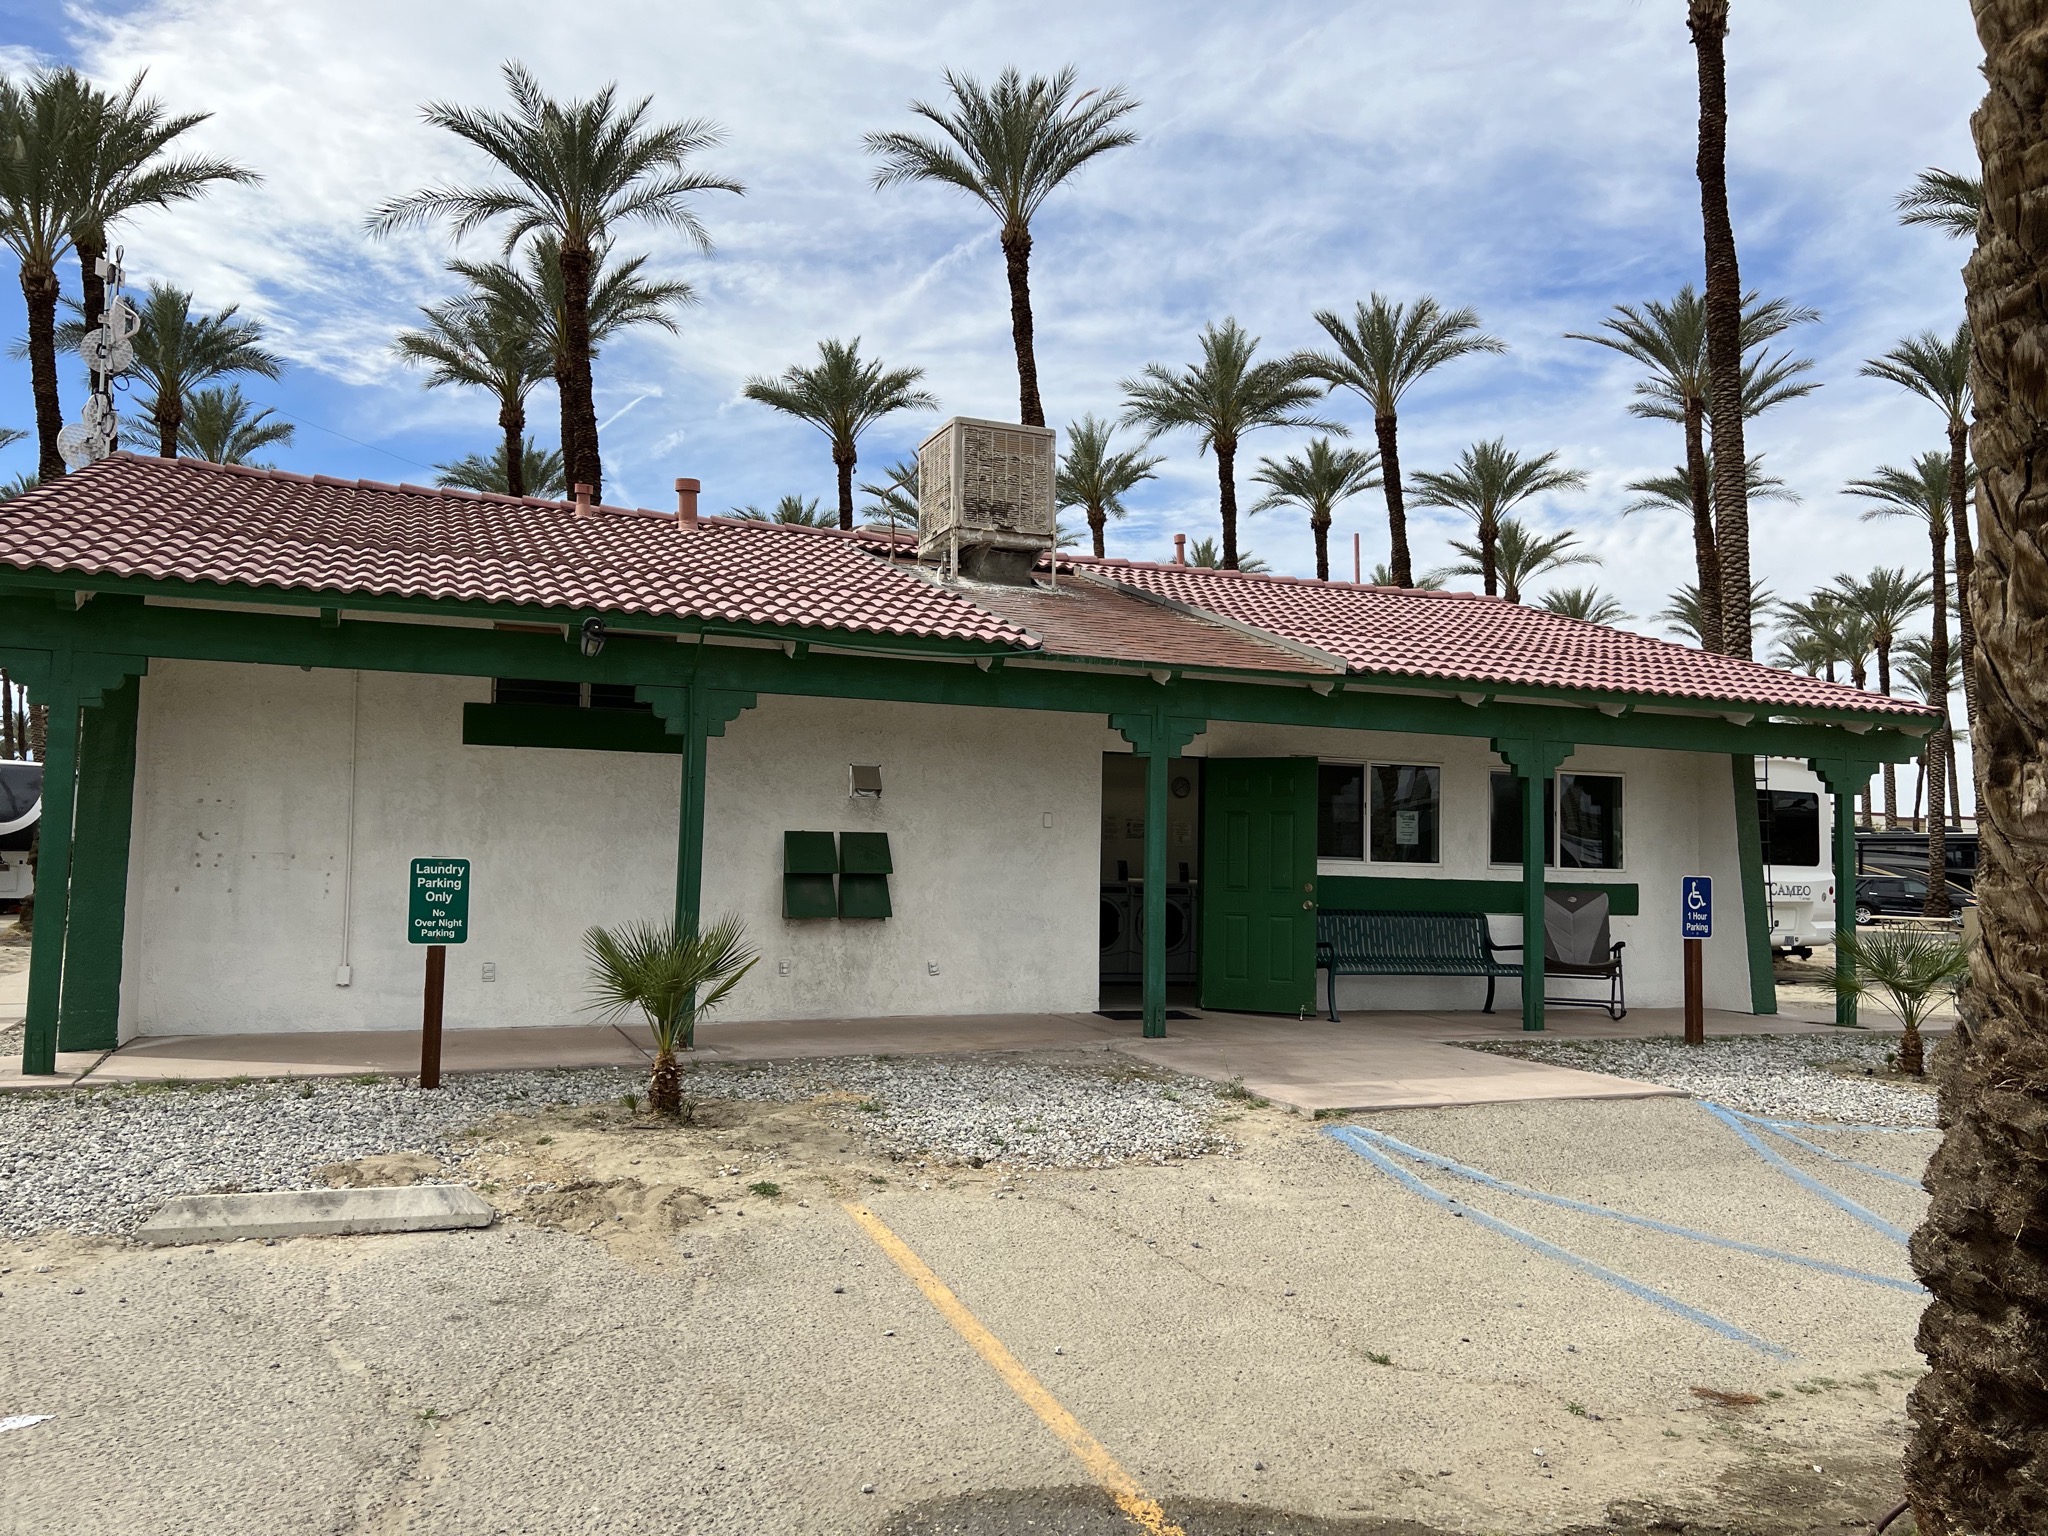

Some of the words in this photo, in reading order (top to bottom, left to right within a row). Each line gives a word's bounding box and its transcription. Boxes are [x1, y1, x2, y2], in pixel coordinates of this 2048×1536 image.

[416, 864, 465, 876] Laundry
[417, 878, 461, 890] Parking
[1770, 882, 1811, 897] CAMEO
[425, 891, 452, 904] Only
[1693, 912, 1707, 920] Hour
[438, 919, 462, 928] Night
[1686, 923, 1708, 933] Parking
[421, 929, 454, 938] Parking
